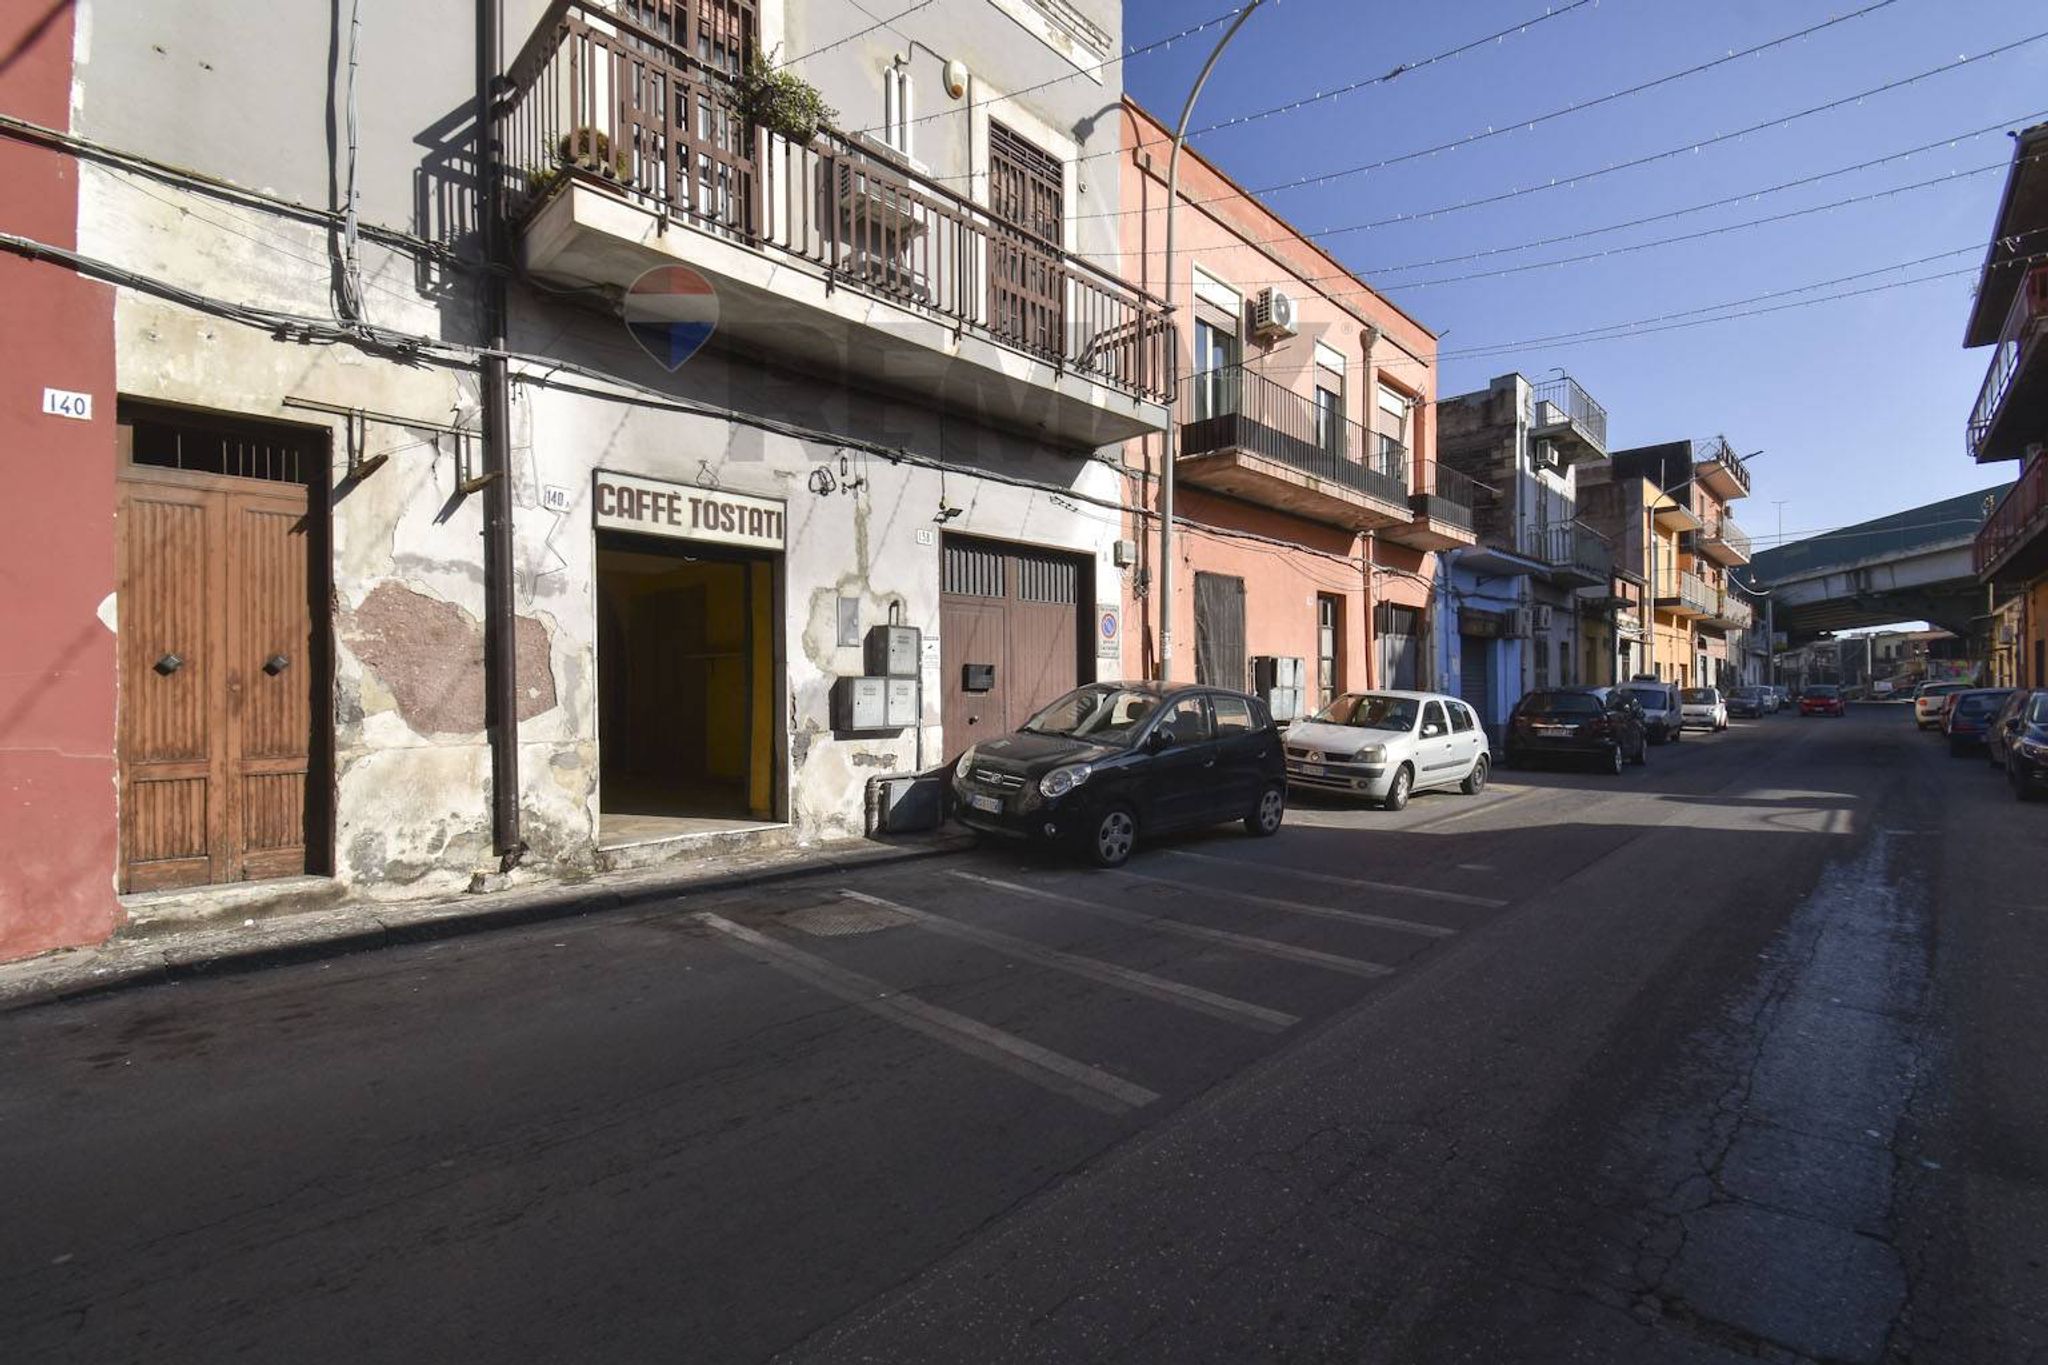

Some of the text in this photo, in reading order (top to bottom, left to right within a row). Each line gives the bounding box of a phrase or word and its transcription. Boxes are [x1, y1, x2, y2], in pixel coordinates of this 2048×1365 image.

[51, 393, 86, 415] 140
[547, 490, 564, 506] 140
[597, 482, 783, 540] CAFFÈ TOSTATI
